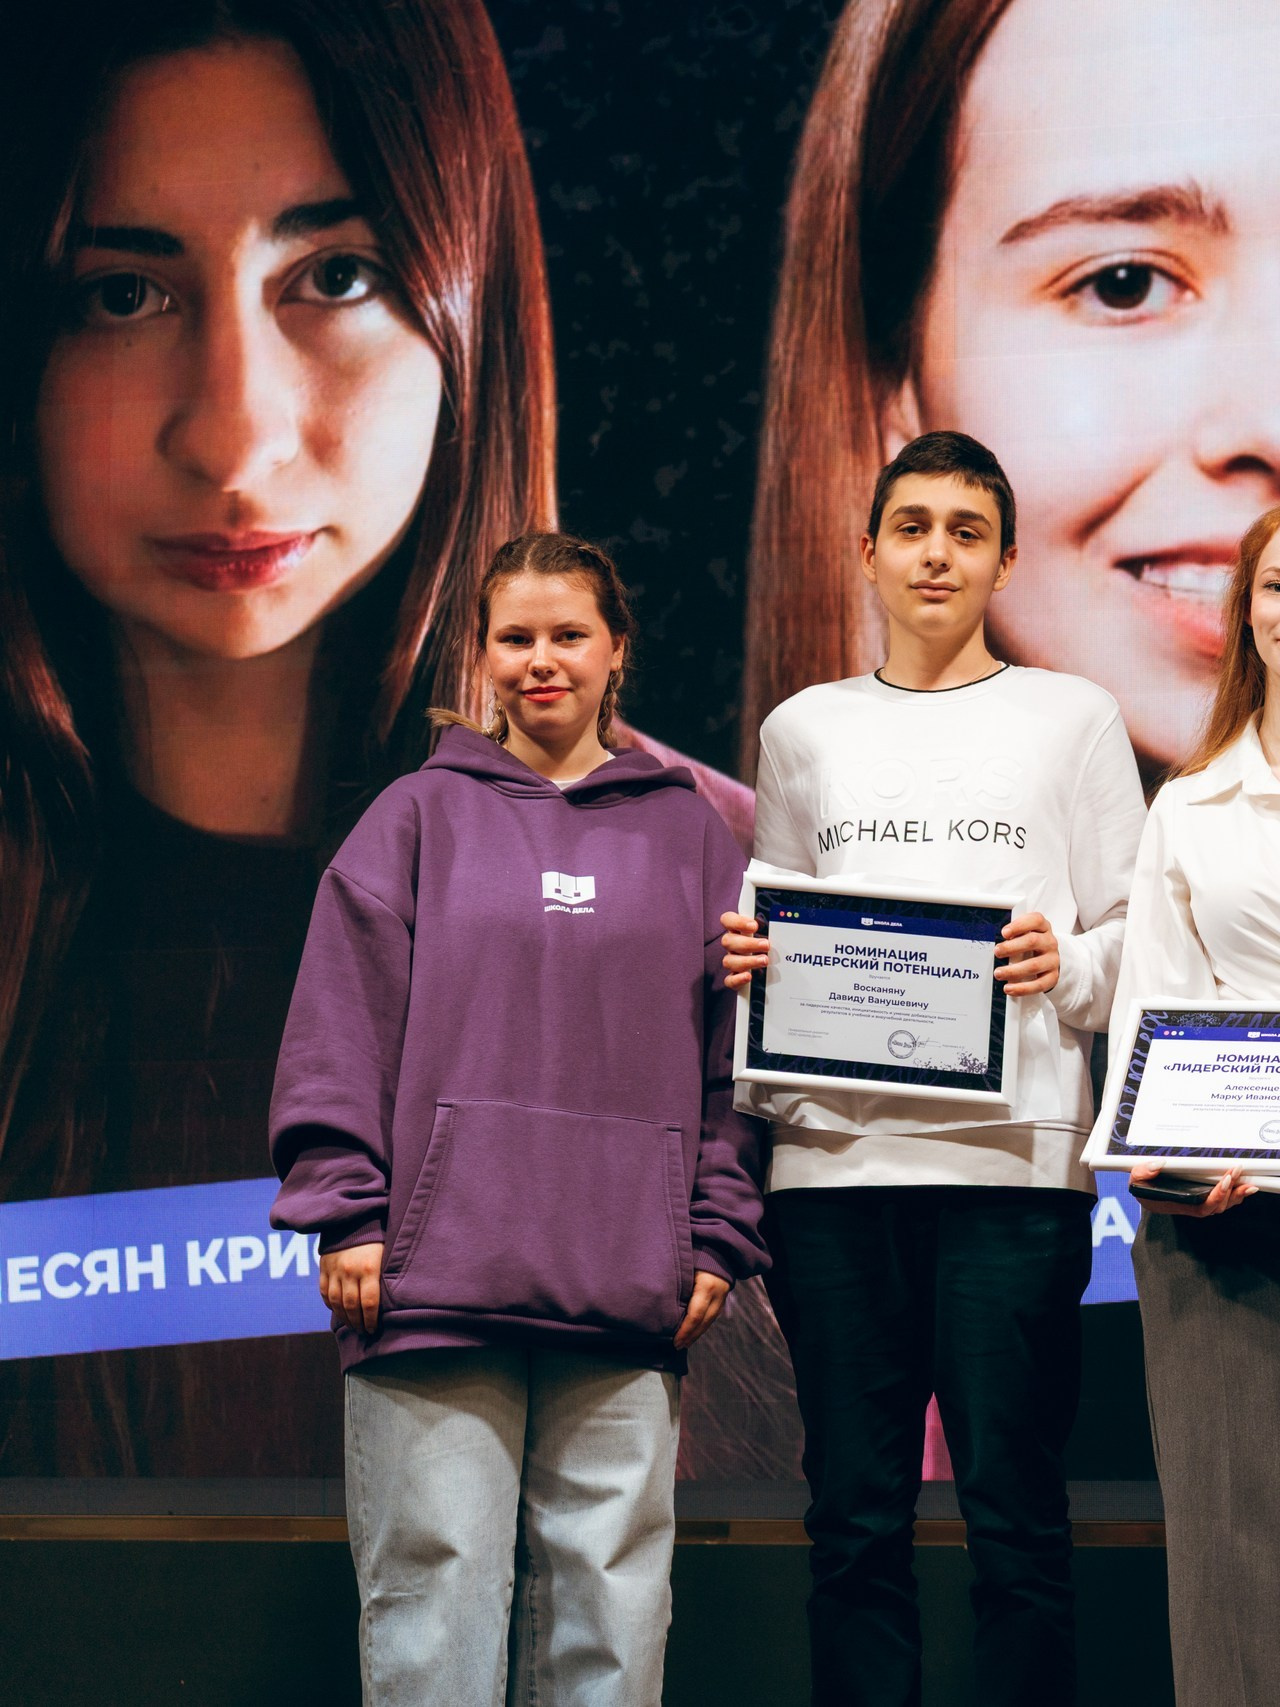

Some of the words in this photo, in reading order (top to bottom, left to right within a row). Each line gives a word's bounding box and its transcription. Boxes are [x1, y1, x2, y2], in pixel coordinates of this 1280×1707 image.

[818, 820, 933, 854] MICHAEL
[948, 820, 1027, 849] KORS
[544, 904, 572, 913] ШКОЛА
[834, 944, 928, 962] НОМИНАЦИЯ
[785, 953, 880, 971] «ЛИДЕРСКИЙ
[883, 962, 980, 980] ПОТЕНЦИАЛ»
[853, 983, 906, 996] Восканяну
[829, 992, 865, 1005] Давиду
[868, 995, 929, 1010] Ванушевичу
[1163, 1062, 1261, 1074] «ЛИДЕРСКИЙ
[1210, 1093, 1243, 1102] Марку
[0, 1243, 165, 1303] ЕСЯН
